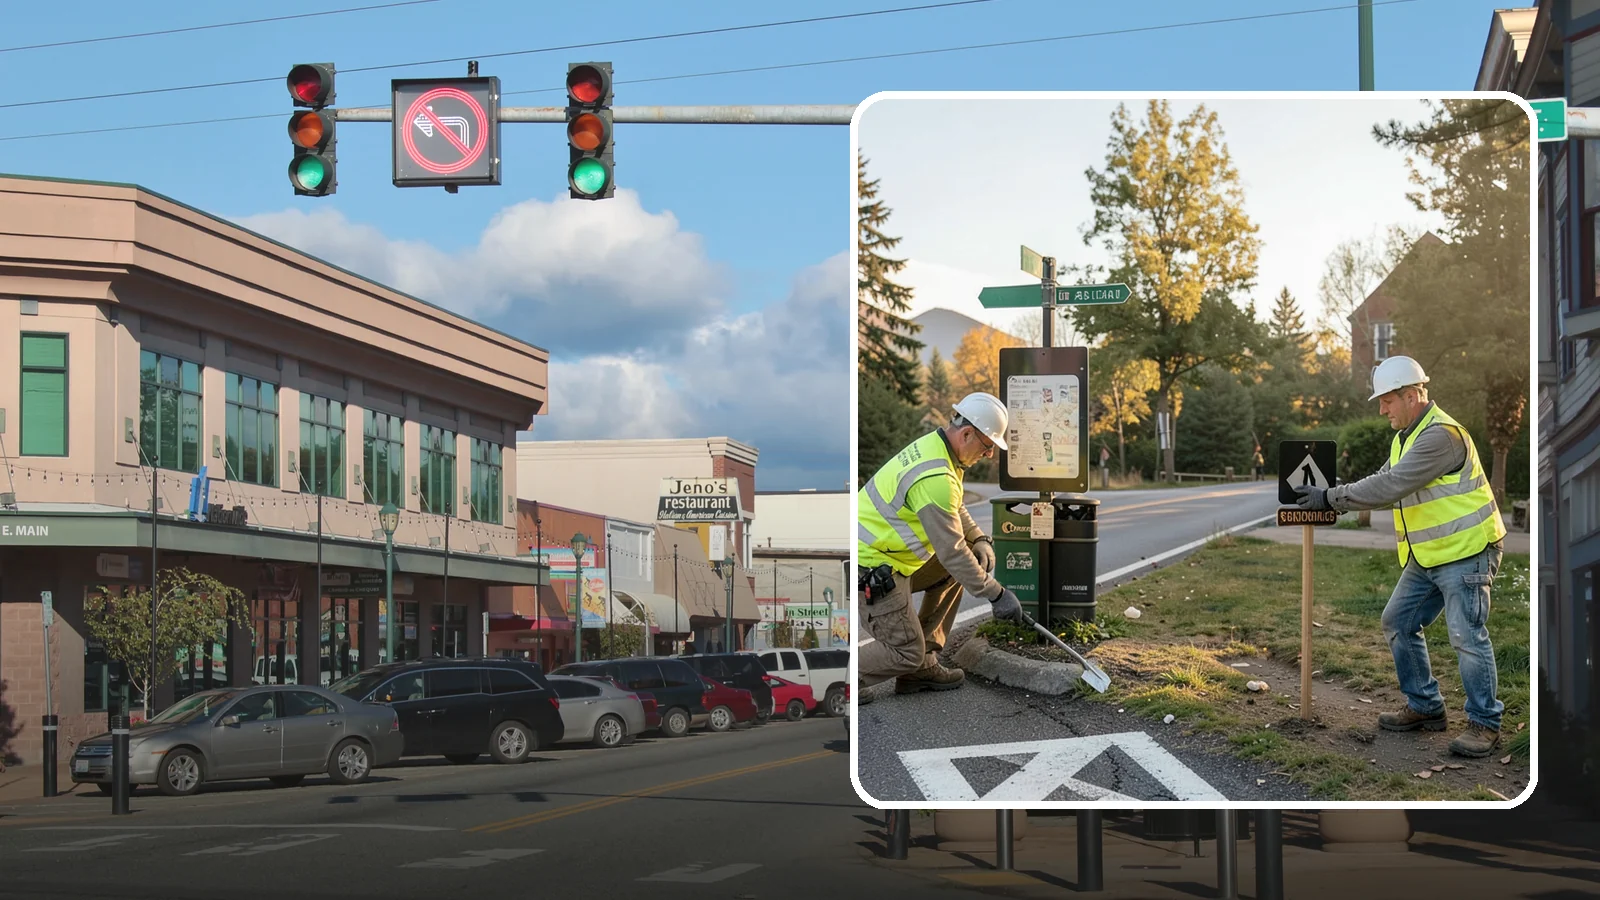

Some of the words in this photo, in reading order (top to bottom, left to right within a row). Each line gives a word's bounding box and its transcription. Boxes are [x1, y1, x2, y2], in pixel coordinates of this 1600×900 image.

[670, 480, 727, 494] Jeno's
[665, 496, 731, 509] restaurant
[686, 510, 714, 519] American
[715, 510, 737, 519] Cuisine
[2, 525, 13, 536] E.
[15, 525, 49, 536] MAIN
[797, 607, 829, 616] Street
